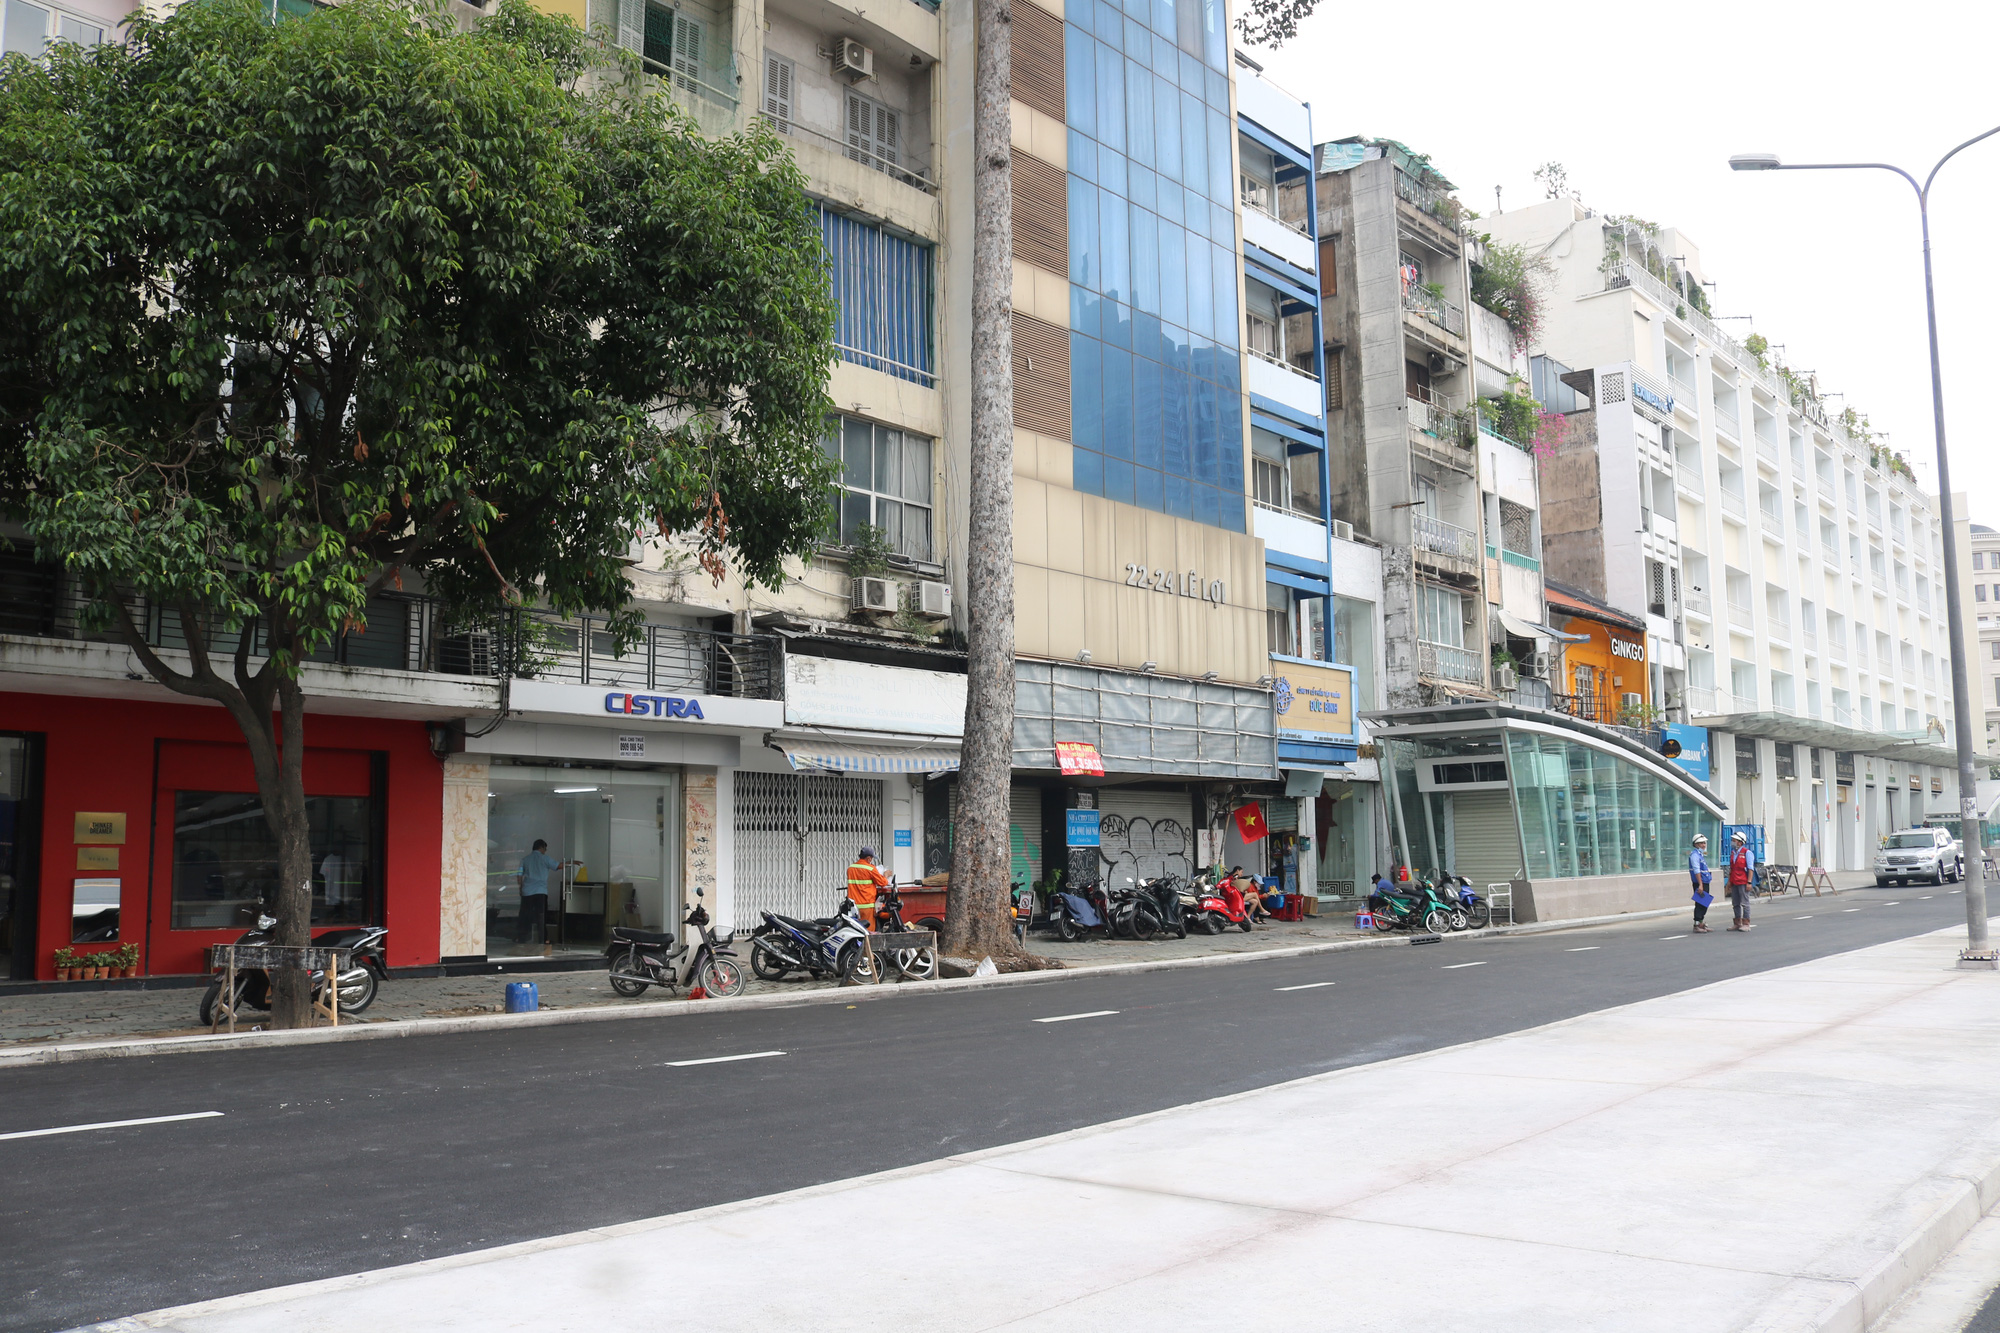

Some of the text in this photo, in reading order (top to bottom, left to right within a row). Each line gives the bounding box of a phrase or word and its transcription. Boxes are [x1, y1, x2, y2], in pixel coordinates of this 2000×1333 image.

[1803, 399, 1830, 430] ROLEX
[1126, 563, 1226, 609] 22-24 LÊ LỢI
[1611, 638, 1644, 662] GINKGO
